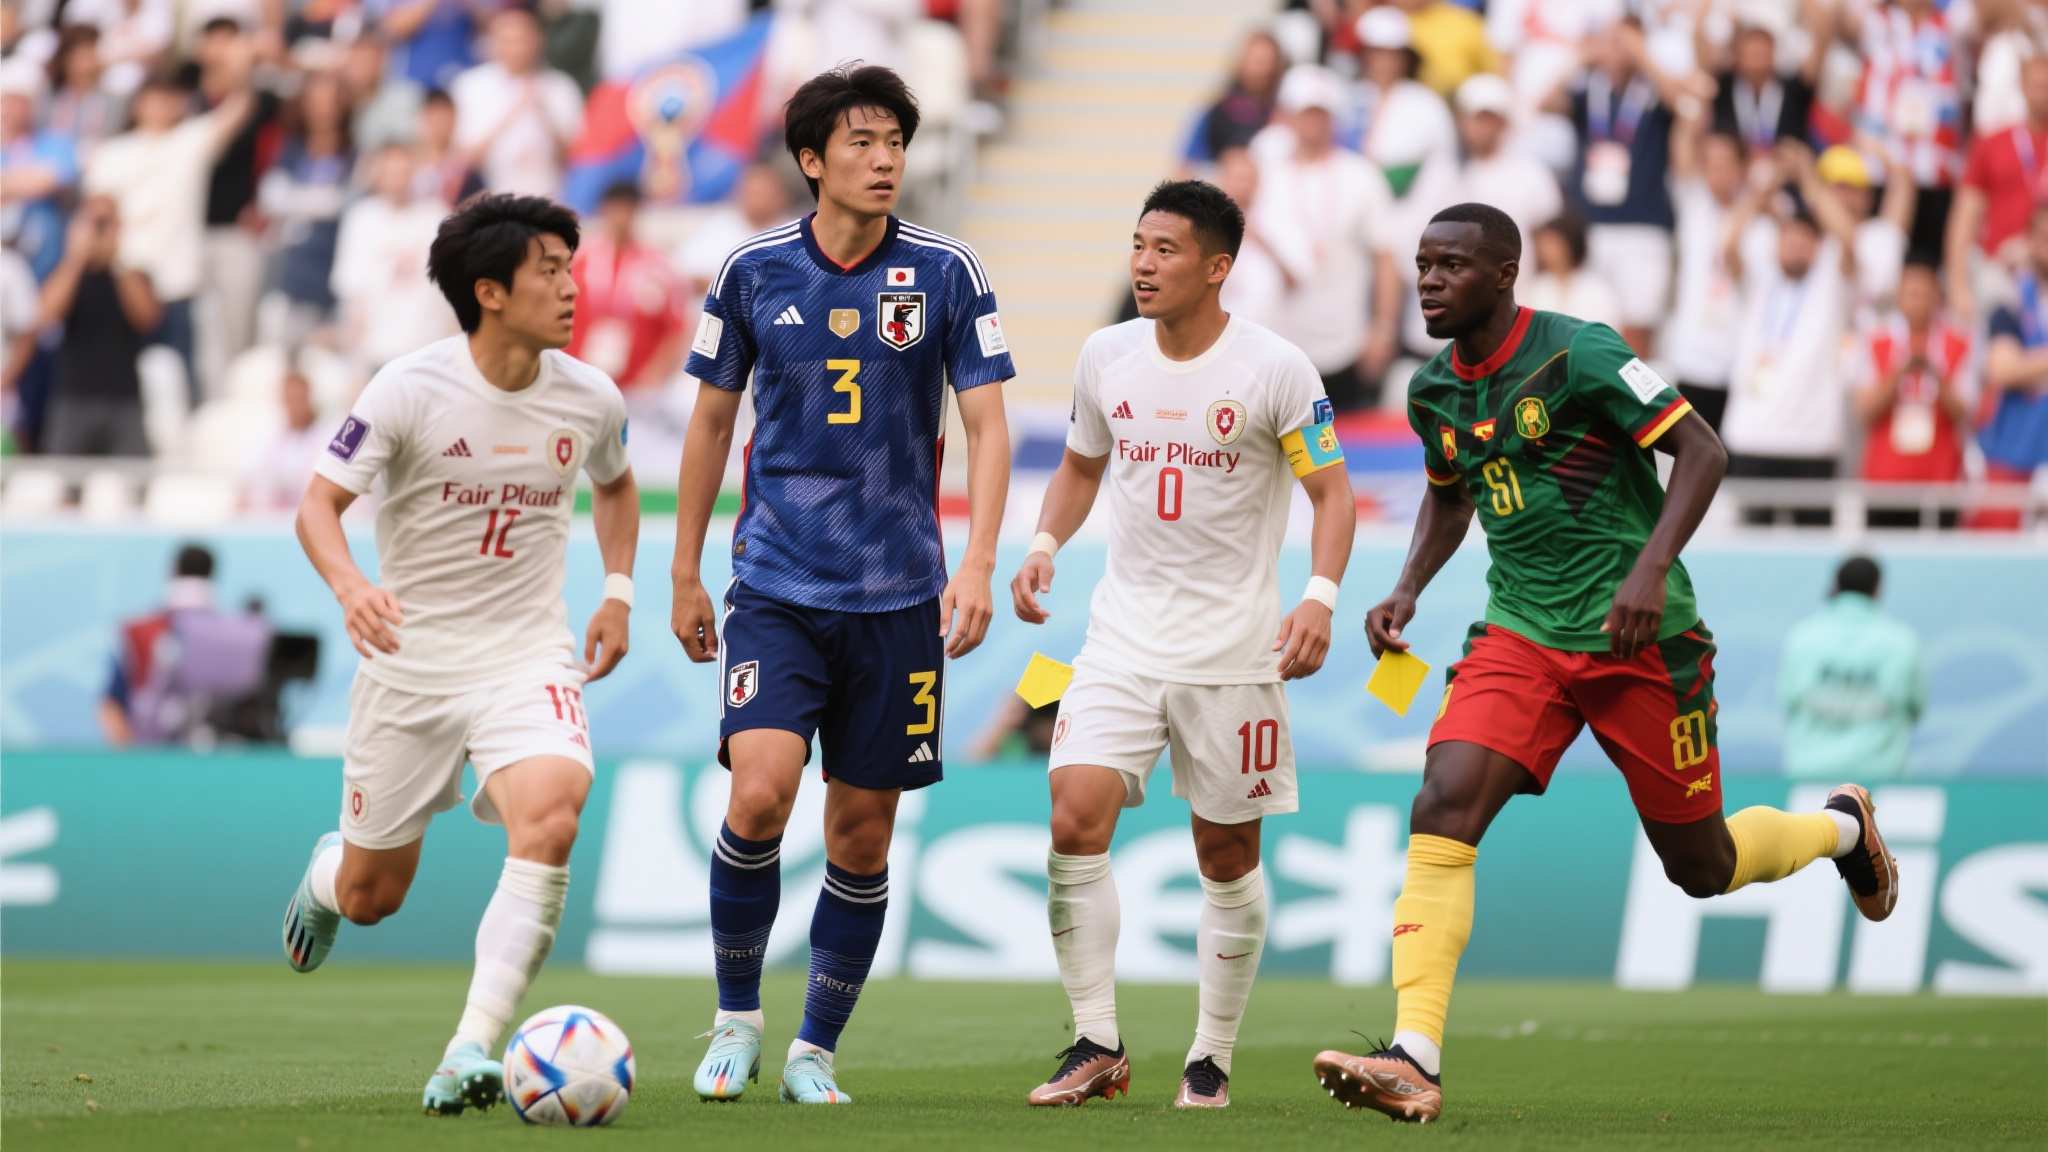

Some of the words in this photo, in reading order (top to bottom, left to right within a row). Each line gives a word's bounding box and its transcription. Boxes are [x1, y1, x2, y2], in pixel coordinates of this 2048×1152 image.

[826, 358, 861, 424] 3
[1118, 438, 1160, 462] Fair
[442, 481, 495, 505] Fair
[1157, 466, 1183, 521] 0
[906, 670, 937, 735] 3
[1238, 719, 1278, 774] 10
